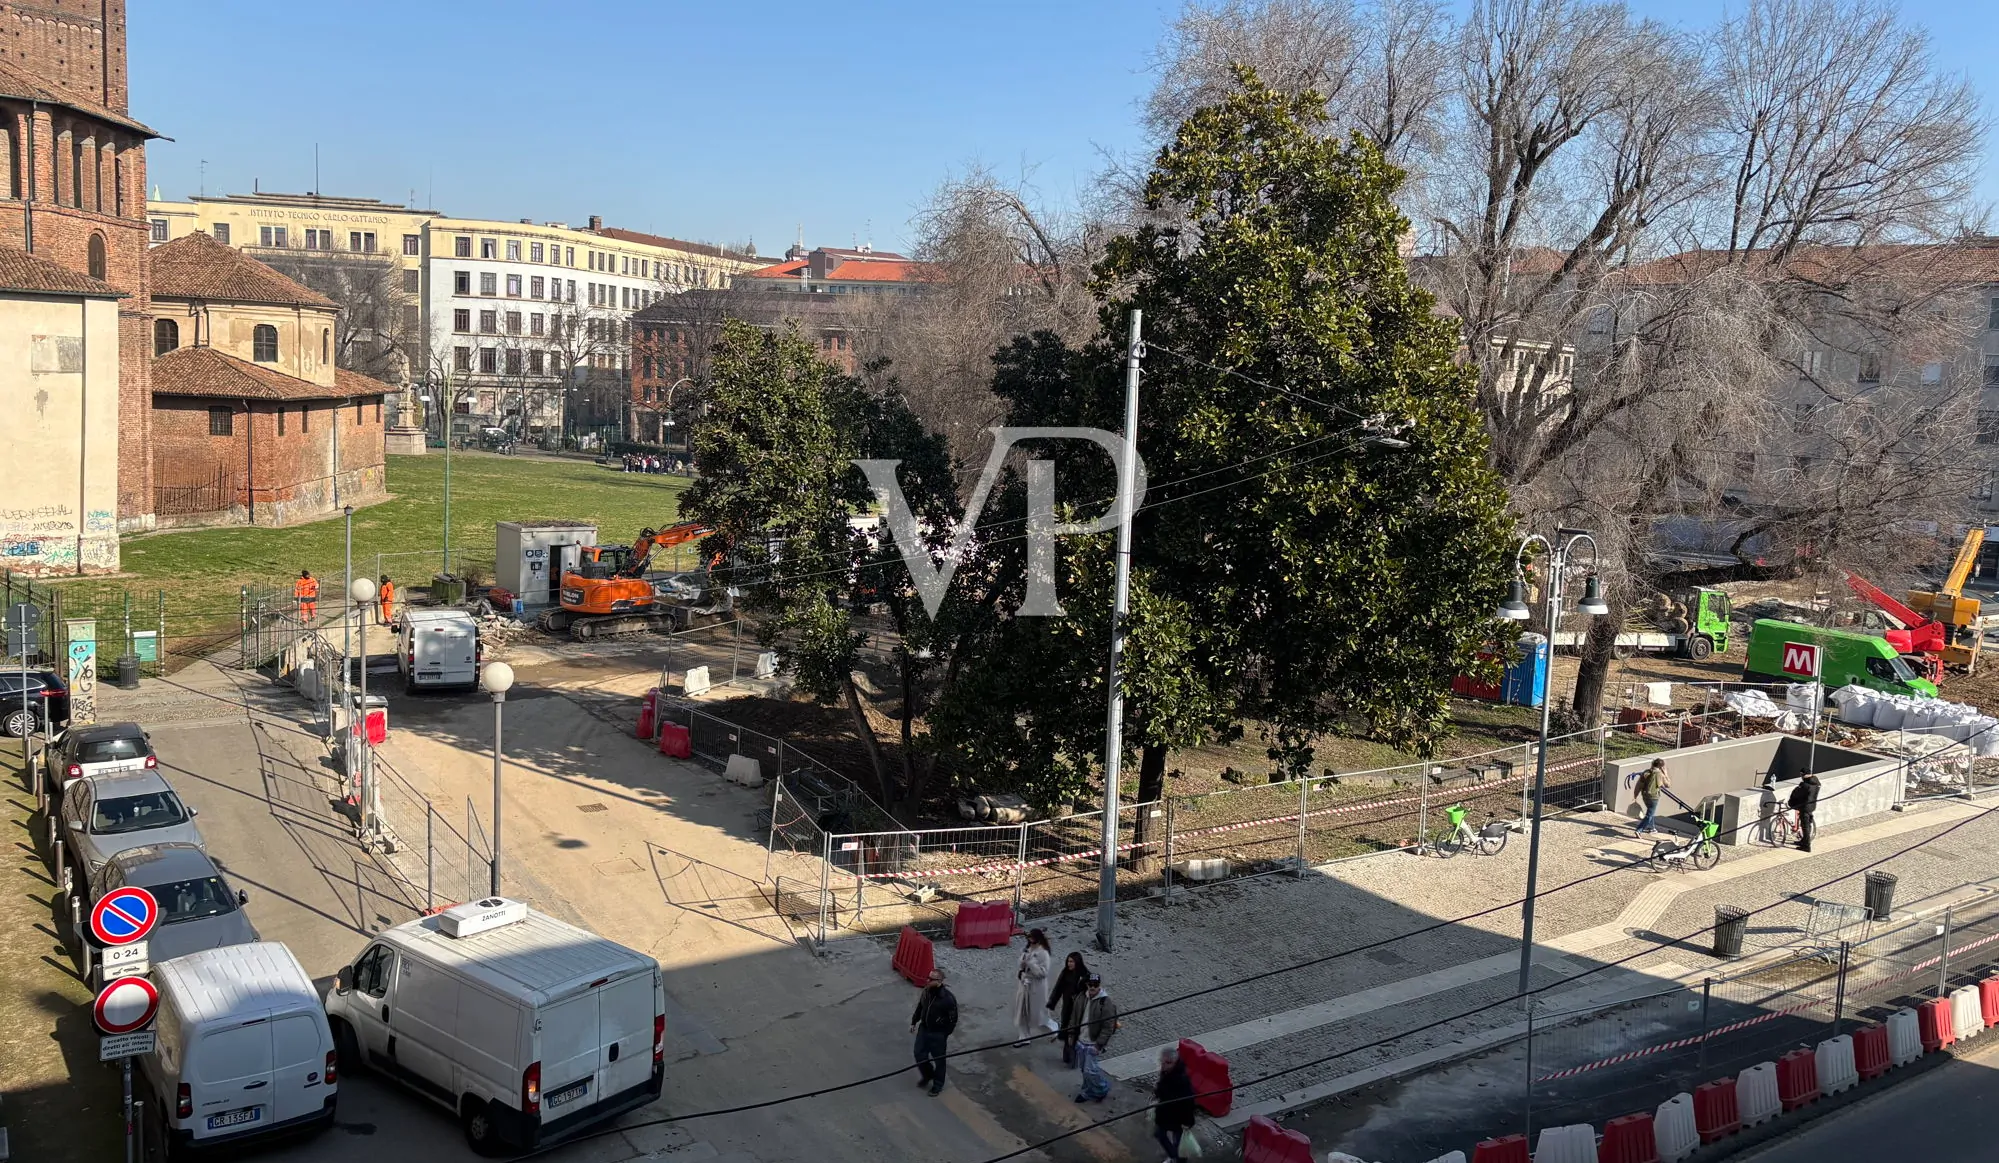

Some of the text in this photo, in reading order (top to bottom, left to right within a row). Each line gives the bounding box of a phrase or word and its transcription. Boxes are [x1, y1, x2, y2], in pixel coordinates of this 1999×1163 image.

[288, 211, 320, 221] TECNICO
[323, 213, 348, 222] CARLO
[350, 215, 388, 224] CATTANEO
[1784, 648, 1812, 672] M
[482, 911, 506, 921] ZANOTTI
